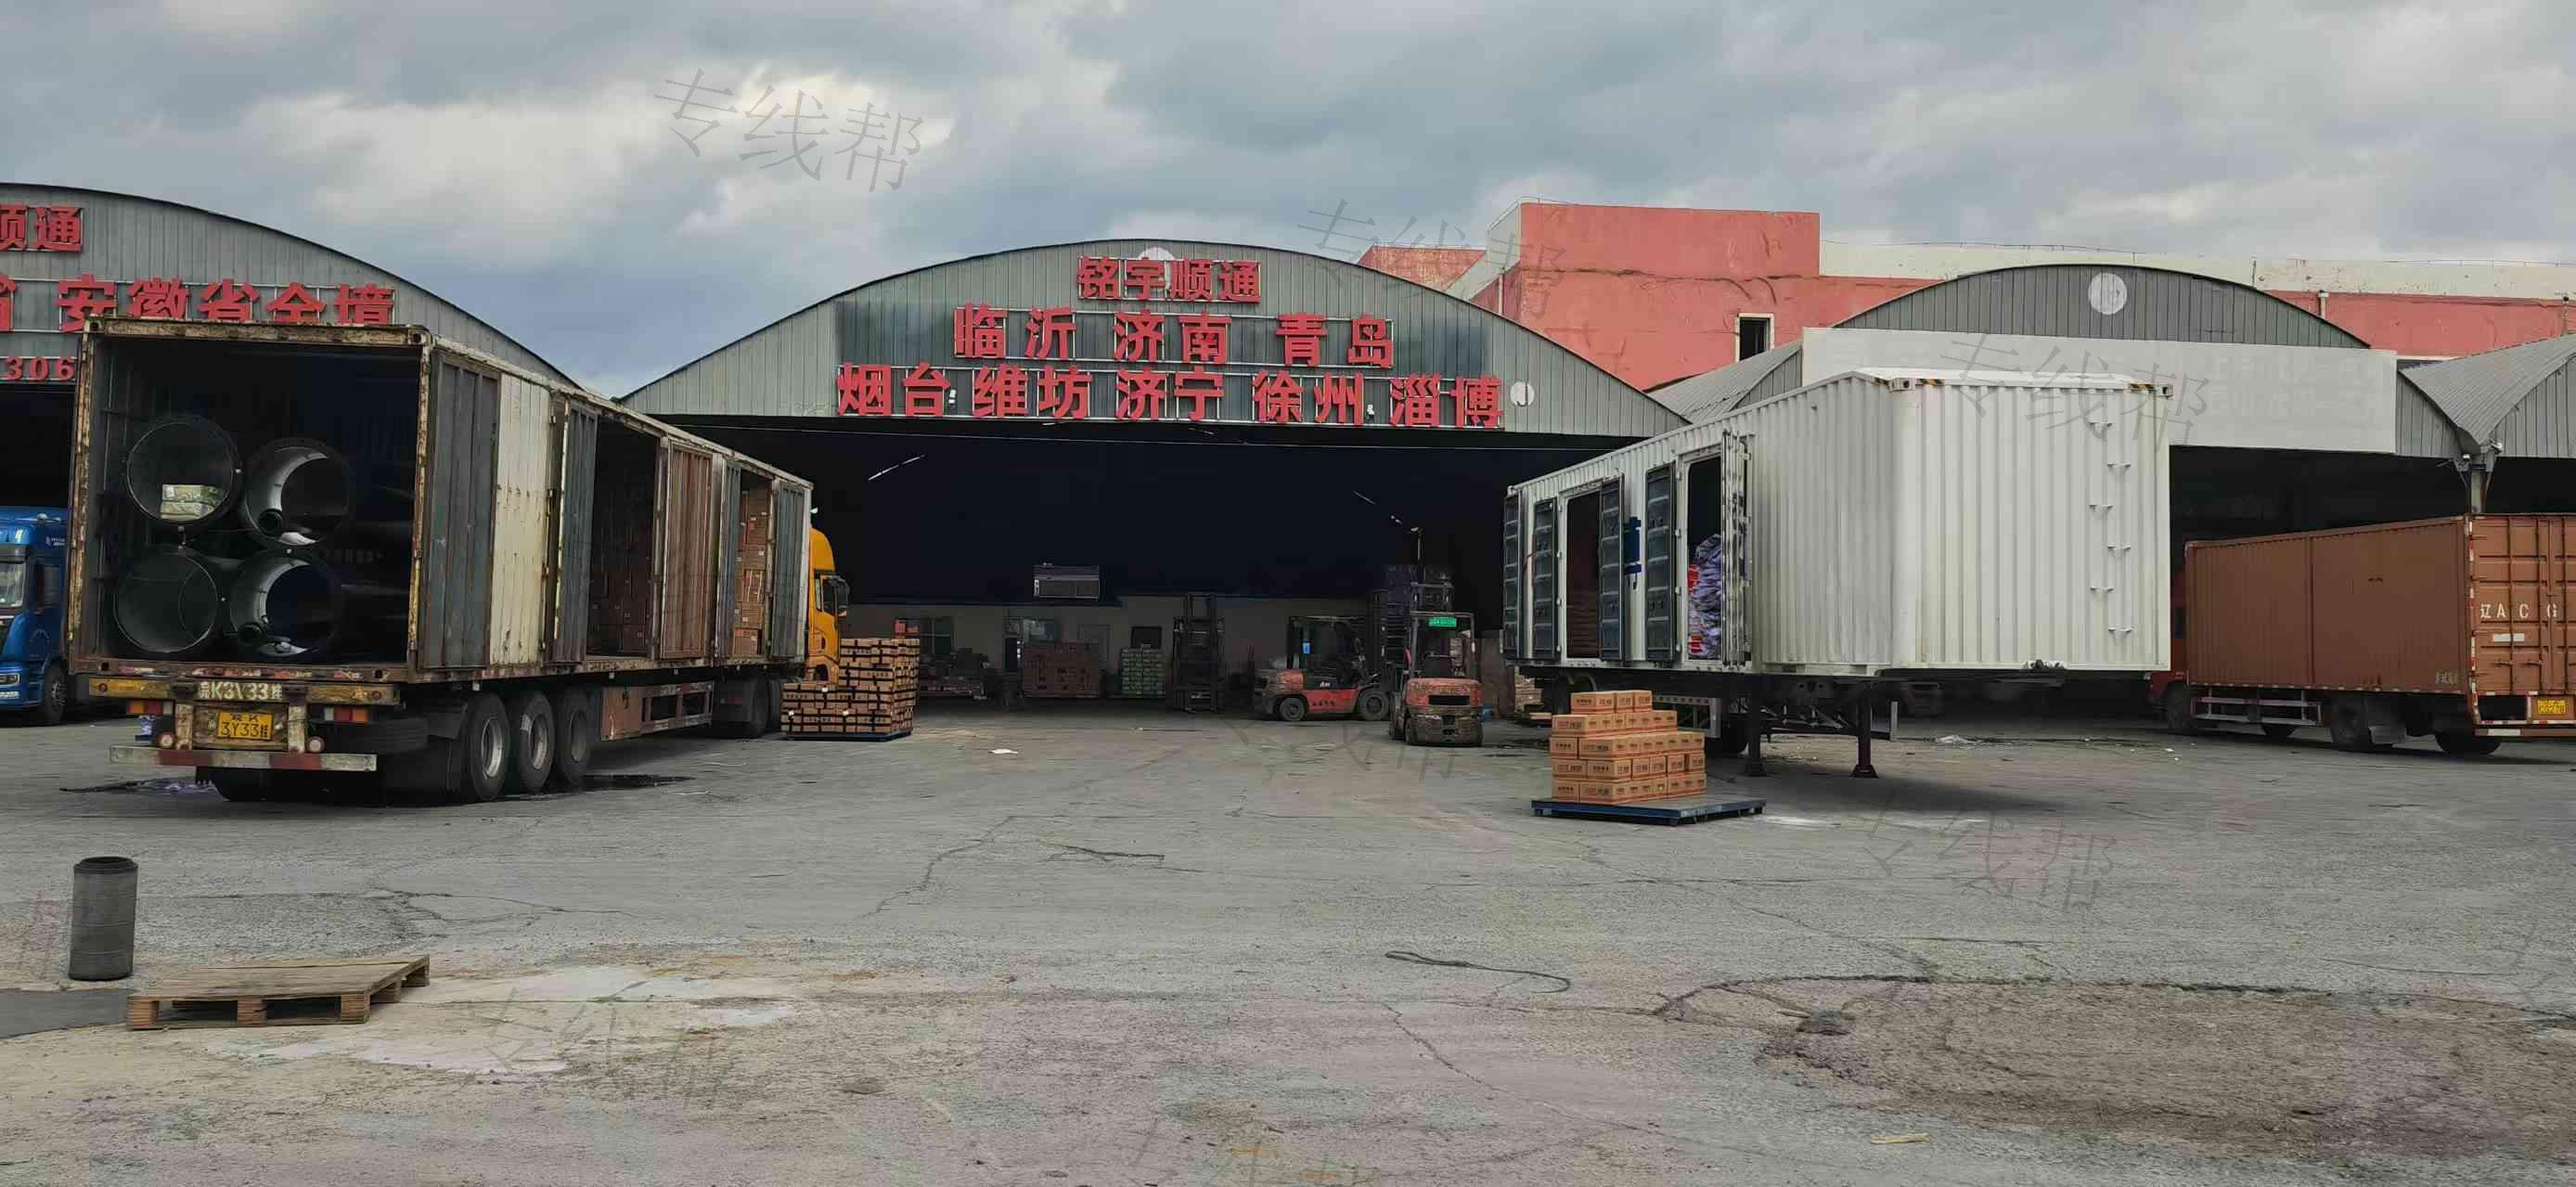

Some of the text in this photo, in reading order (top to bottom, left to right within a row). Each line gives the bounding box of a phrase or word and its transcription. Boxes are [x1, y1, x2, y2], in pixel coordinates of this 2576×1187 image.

[56, 273, 395, 332] 安徽省全境
[1077, 256, 1261, 303] 铭宇顺通
[954, 303, 1394, 368] 临沂 济南 青岛
[3, 355, 75, 381] 306
[836, 363, 1503, 428] 烟台 维坊 济宁 徐州 淄博
